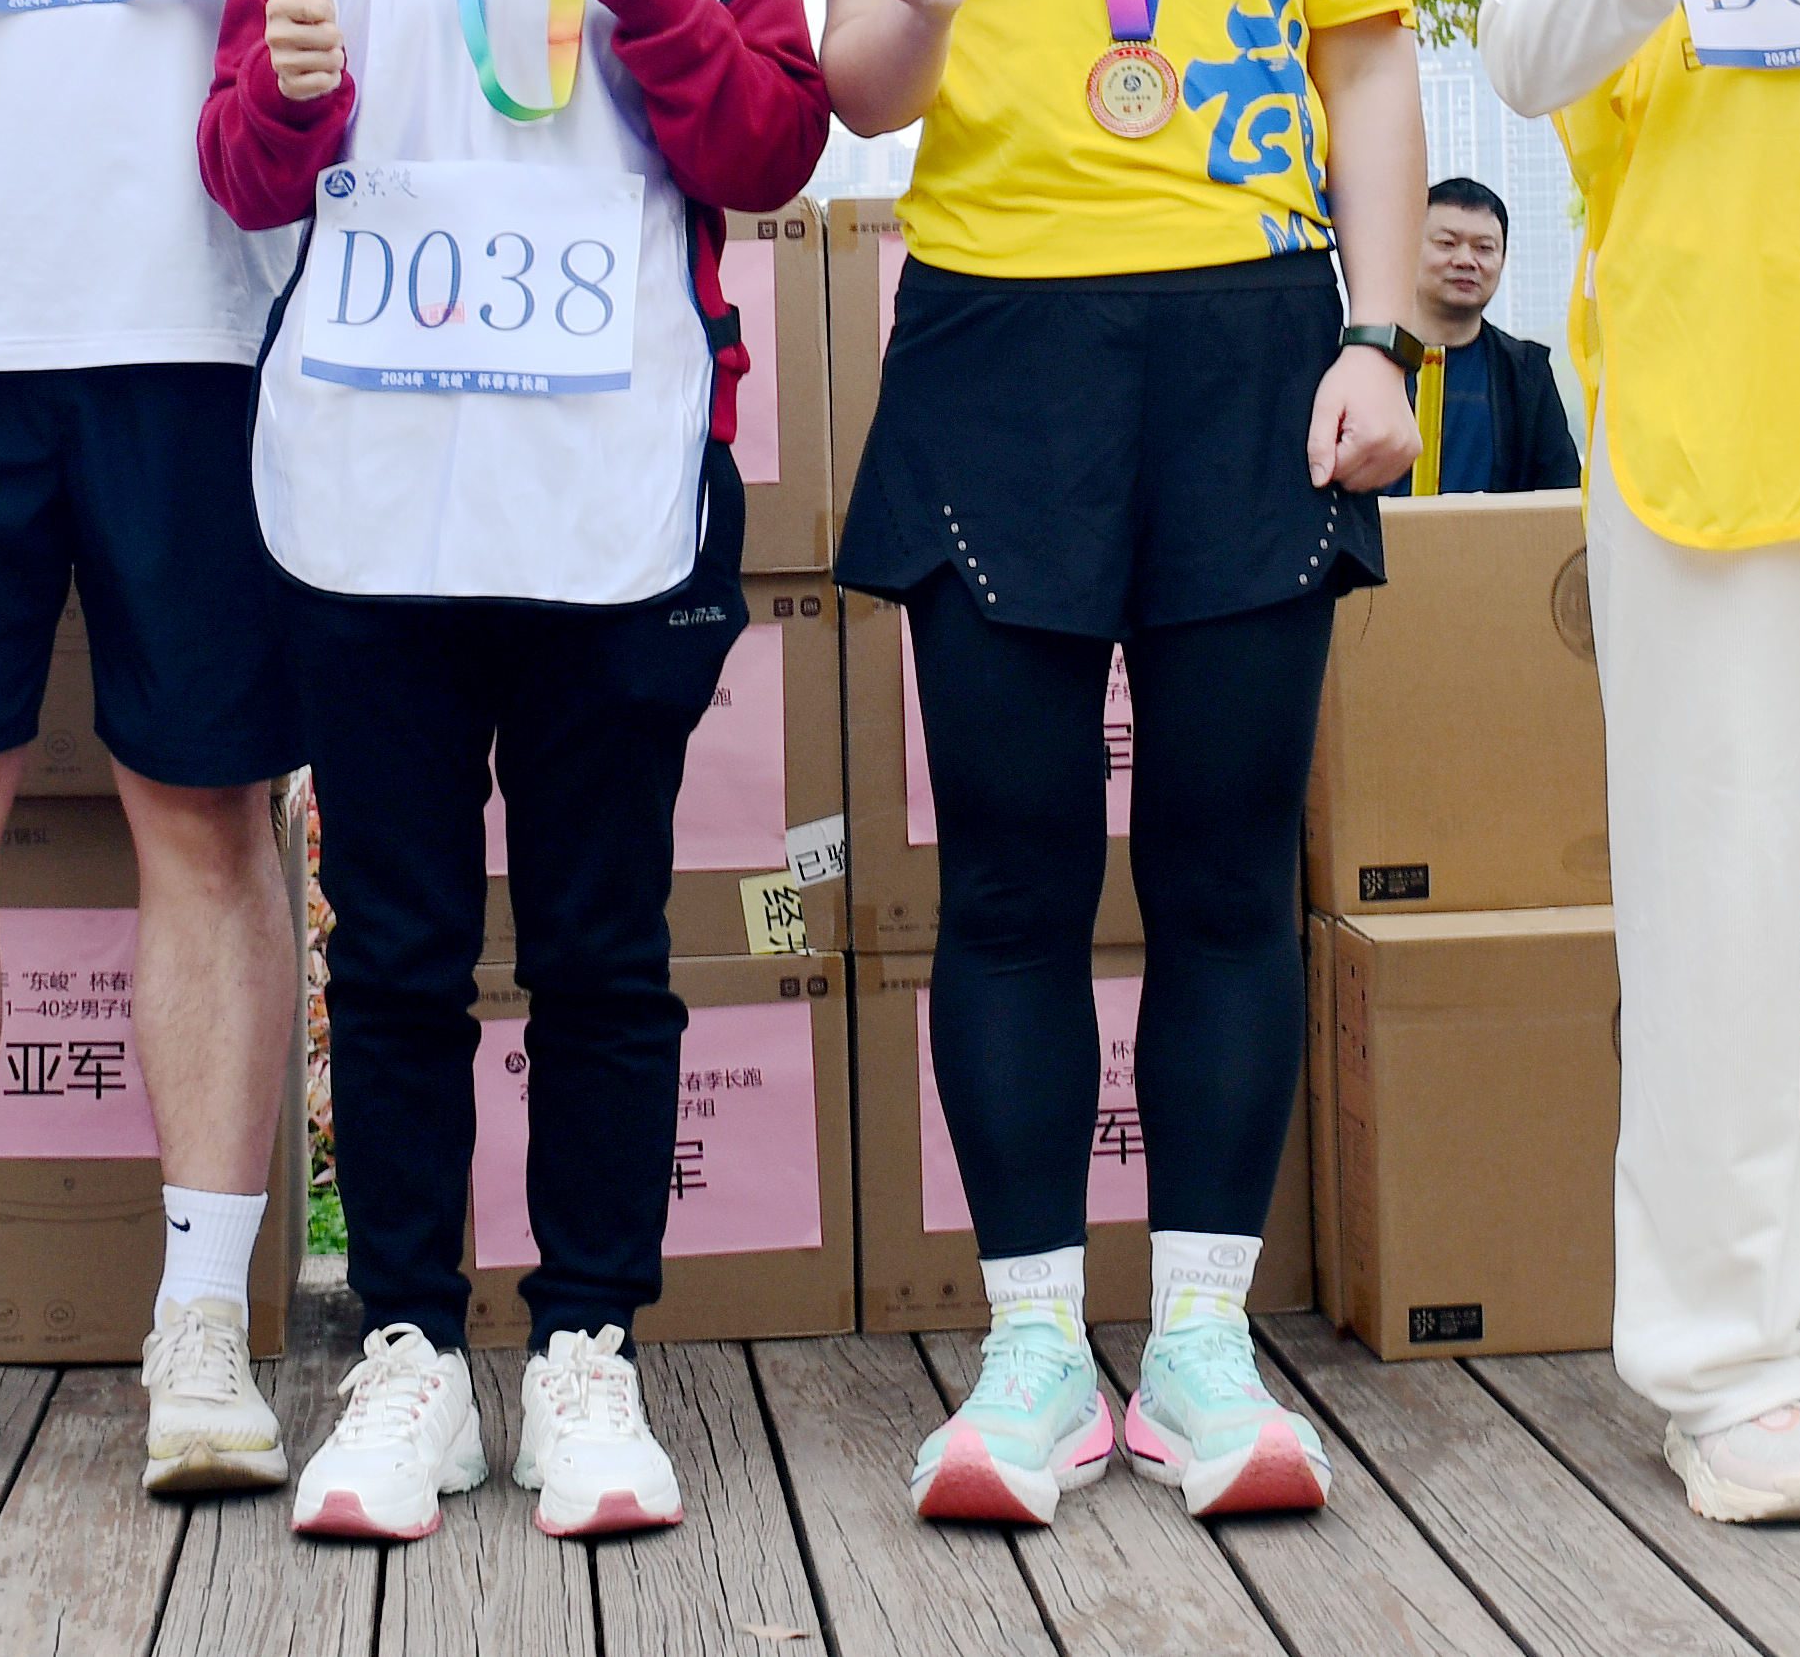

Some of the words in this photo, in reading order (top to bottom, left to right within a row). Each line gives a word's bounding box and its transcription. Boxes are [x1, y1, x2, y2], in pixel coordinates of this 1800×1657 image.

[326, 229, 616, 337] D038
[3, 1041, 127, 1100] 亚军
[679, 1067, 763, 1092] 春季长跑
